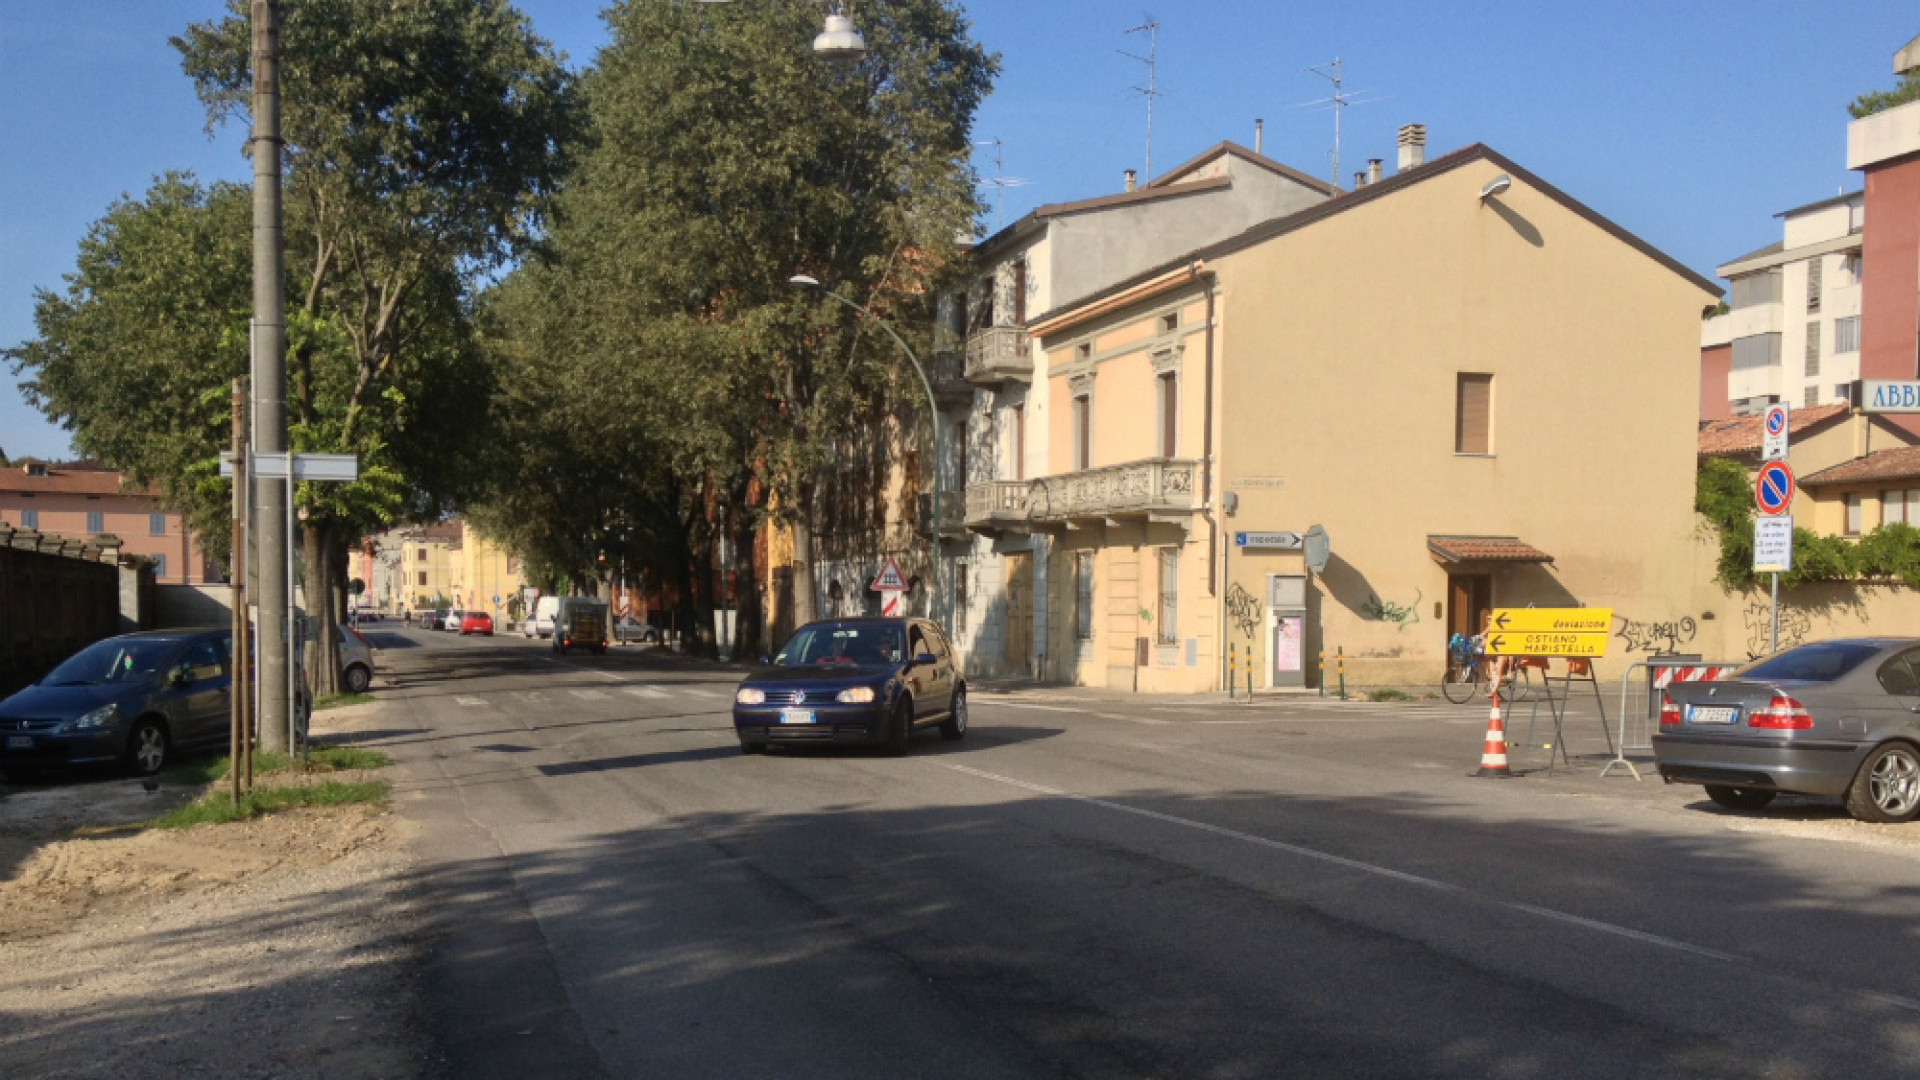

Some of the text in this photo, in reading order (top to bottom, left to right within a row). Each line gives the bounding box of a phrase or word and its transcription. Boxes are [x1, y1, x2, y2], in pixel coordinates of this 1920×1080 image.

[1553, 619, 1606, 628] deviazione
[1526, 634, 1578, 644] OSTIANO
[1524, 644, 1595, 653] MARISTELLA
